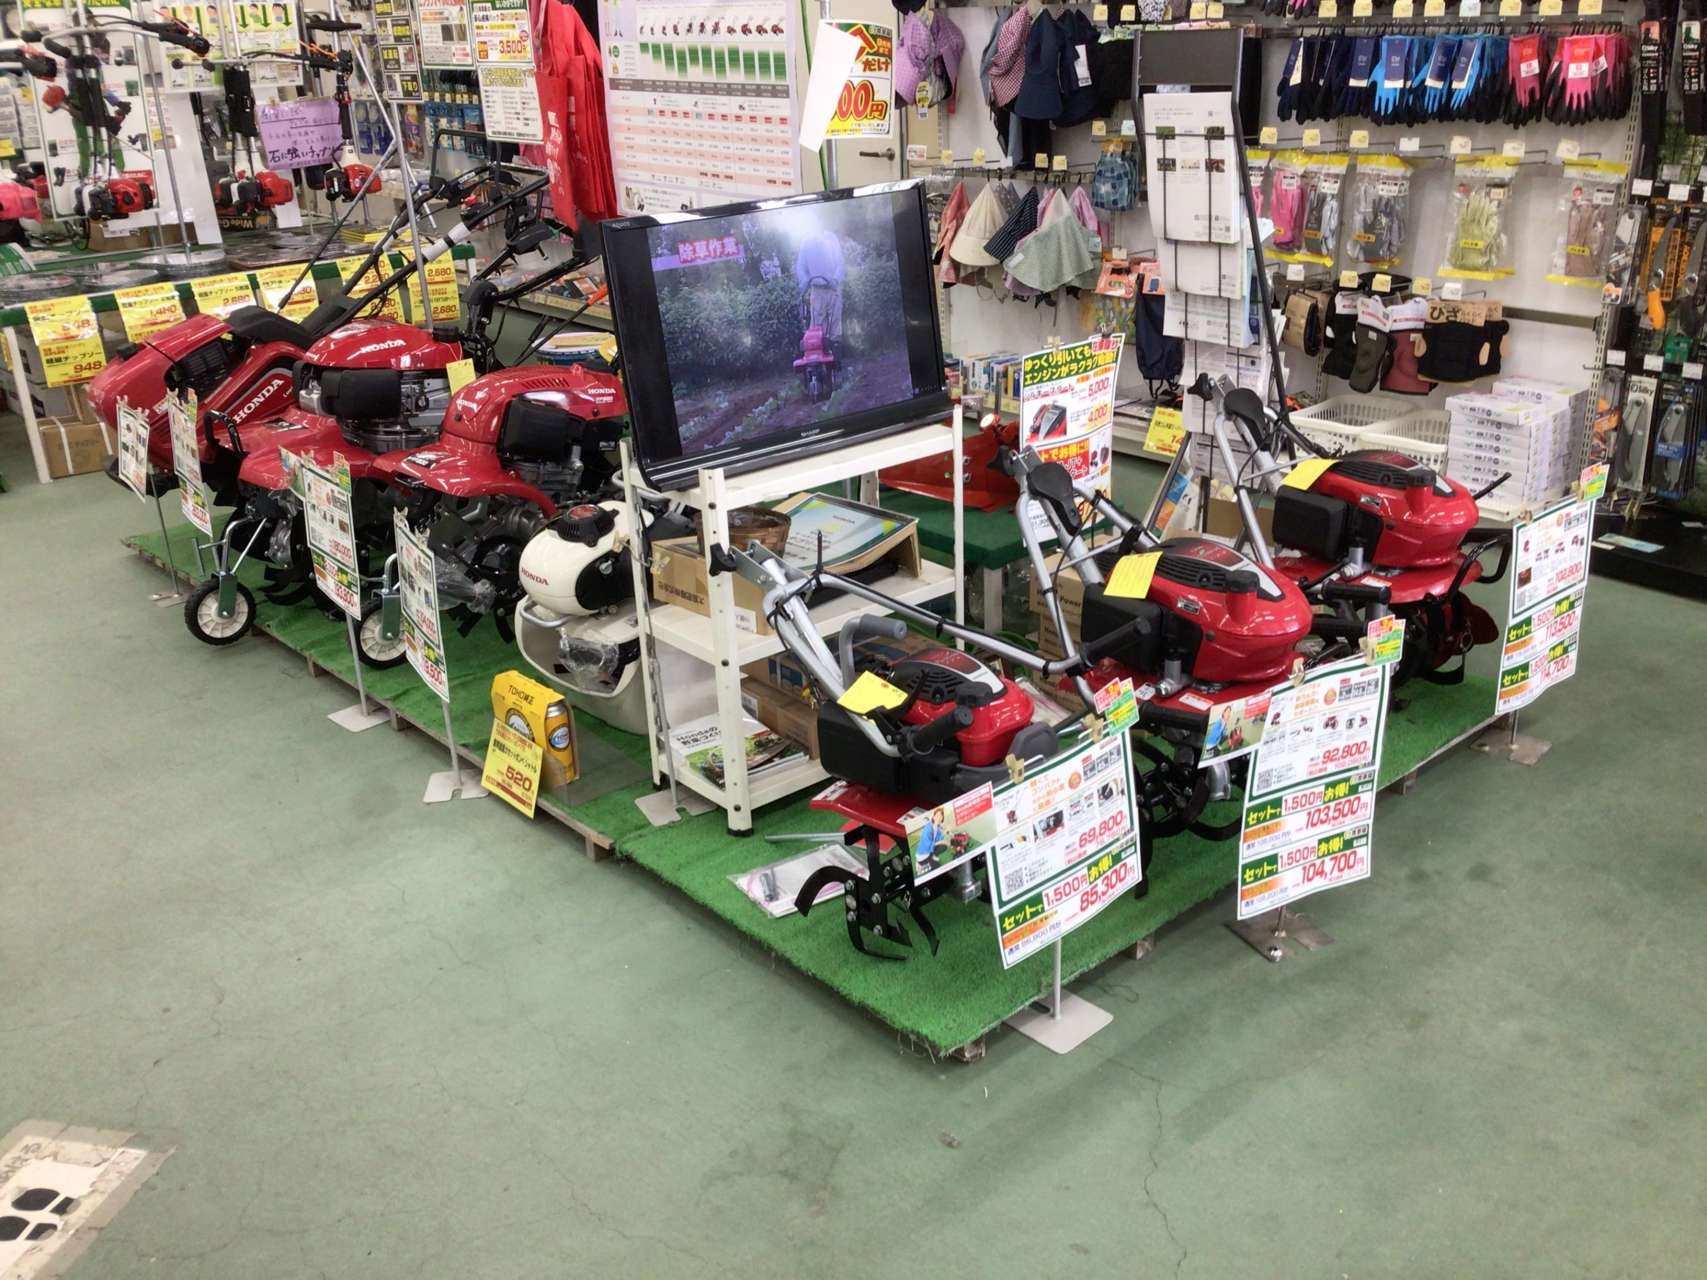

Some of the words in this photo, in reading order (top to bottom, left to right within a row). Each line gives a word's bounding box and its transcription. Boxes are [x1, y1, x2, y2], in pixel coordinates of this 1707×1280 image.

[360, 339, 407, 353] HONDA
[1024, 345, 1091, 371] ゆっくり引いても
[73, 360, 103, 374] 948
[232, 378, 285, 424] HONDA
[520, 567, 550, 587] HONDA
[505, 765, 533, 792] 520
[1283, 790, 1323, 811] 1,500円
[1323, 781, 1350, 802] お得!
[1305, 795, 1369, 830] 103,500円
[1279, 845, 1317, 870] 1,500円
[1317, 836, 1344, 857] お得!
[1302, 850, 1365, 886] 104,700円
[1043, 873, 1088, 907] 1,500円
[1088, 853, 1113, 882] お得!
[1079, 862, 1136, 913] 85,300円
